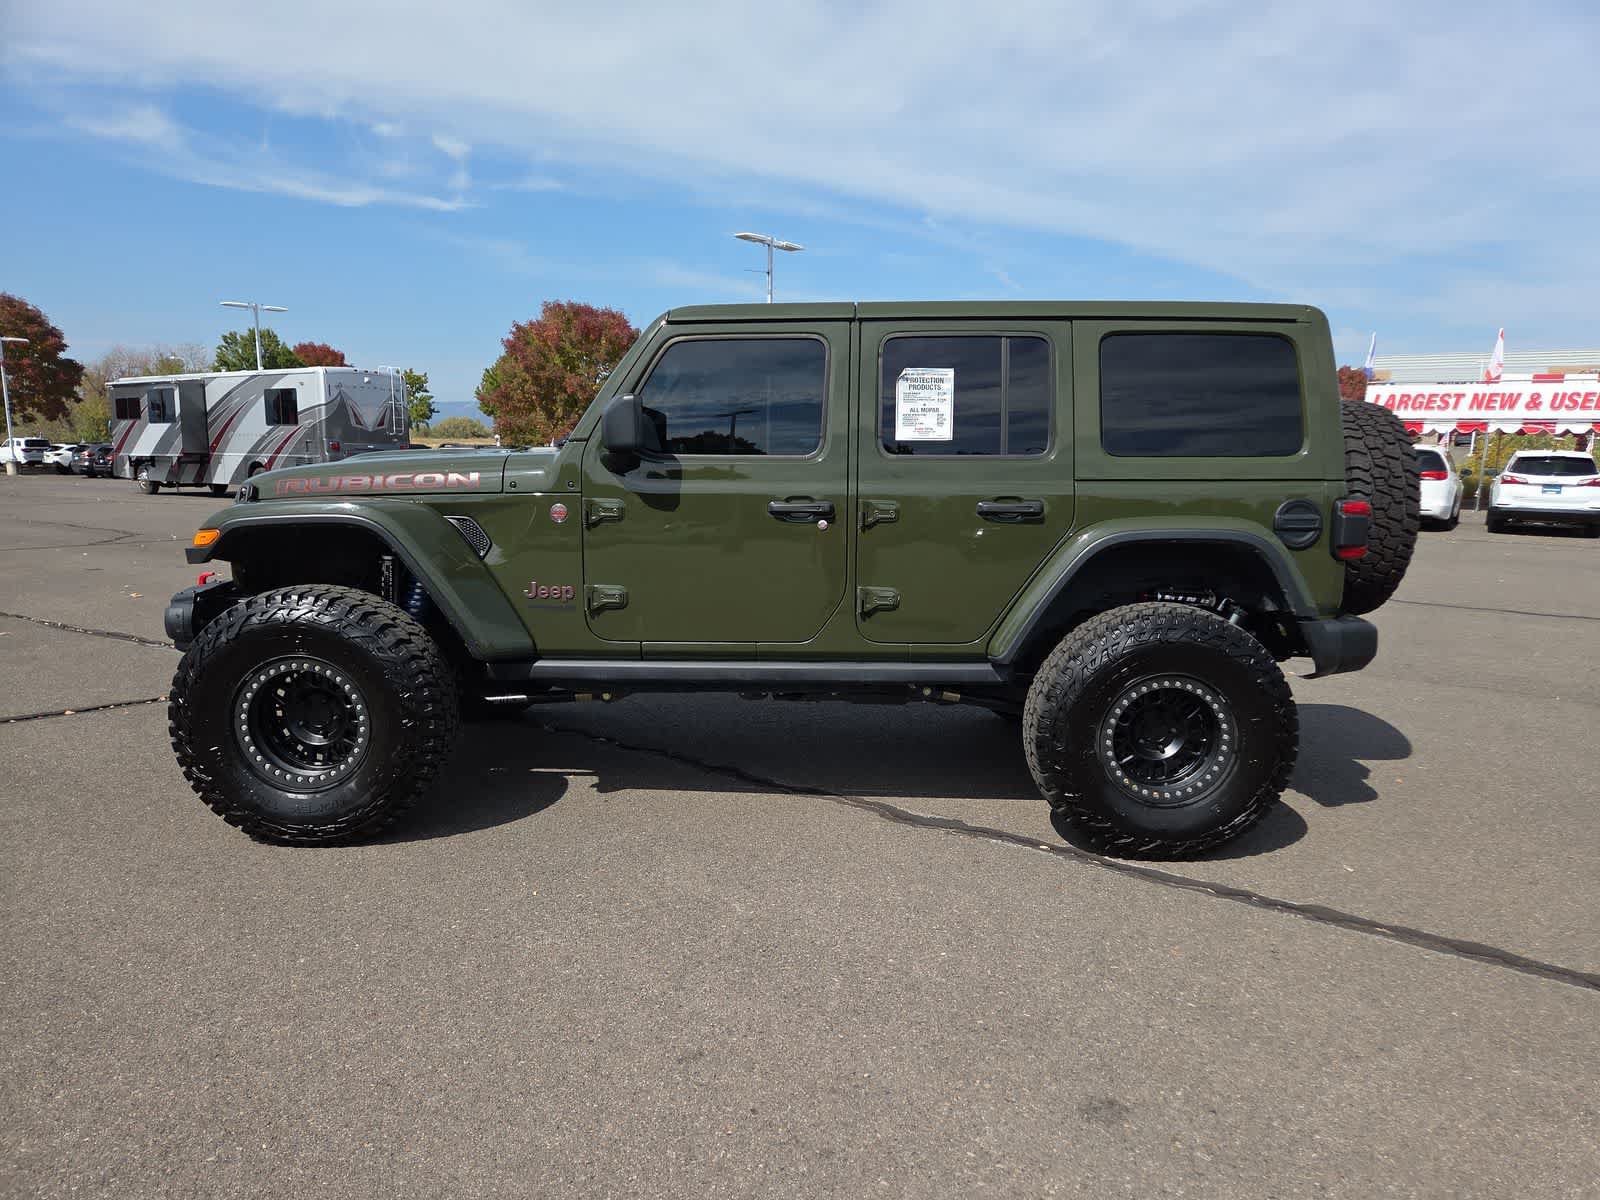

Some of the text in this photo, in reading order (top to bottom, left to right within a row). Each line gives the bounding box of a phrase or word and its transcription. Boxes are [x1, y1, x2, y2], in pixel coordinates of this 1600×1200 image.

[1469, 392, 1522, 411] NEW
[1525, 392, 1543, 411] &
[275, 471, 480, 495] RUBICON
[523, 581, 575, 603] Jeep
